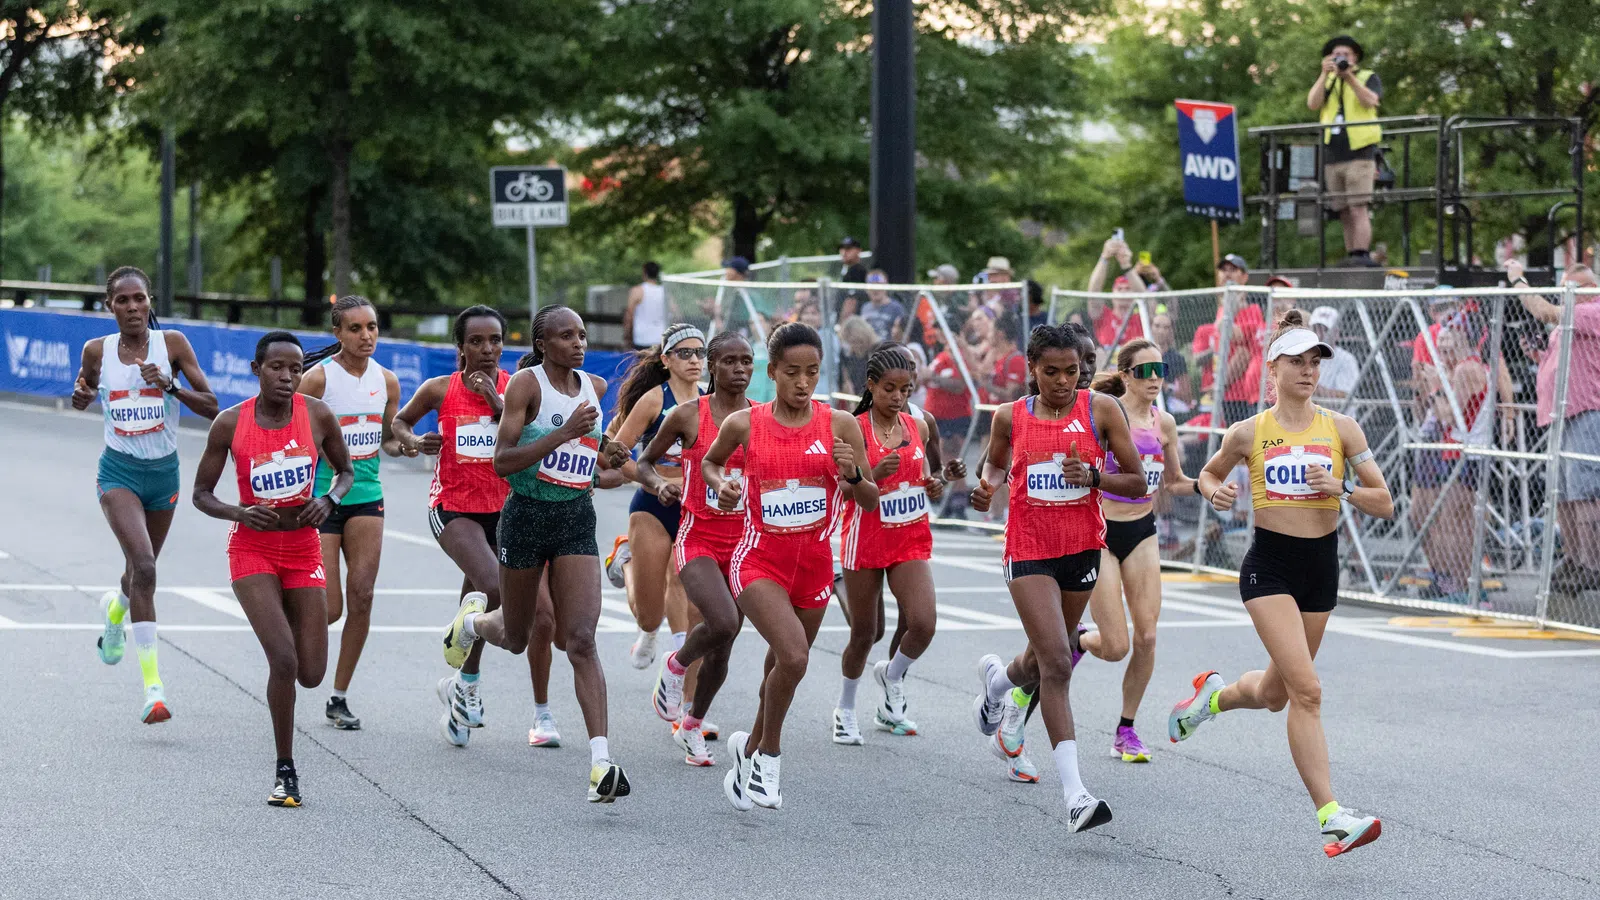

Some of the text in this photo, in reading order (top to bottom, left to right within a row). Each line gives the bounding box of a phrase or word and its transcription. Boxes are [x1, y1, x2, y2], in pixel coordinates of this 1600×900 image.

[1184, 153, 1236, 181] AWD
[496, 206, 561, 221] BIKE LANE
[111, 405, 164, 422] CHEPKURUI
[543, 450, 596, 476] OBIRI
[252, 463, 313, 492] CHEBET
[762, 498, 827, 518] HAMBESE
[881, 492, 925, 517] WUDU
